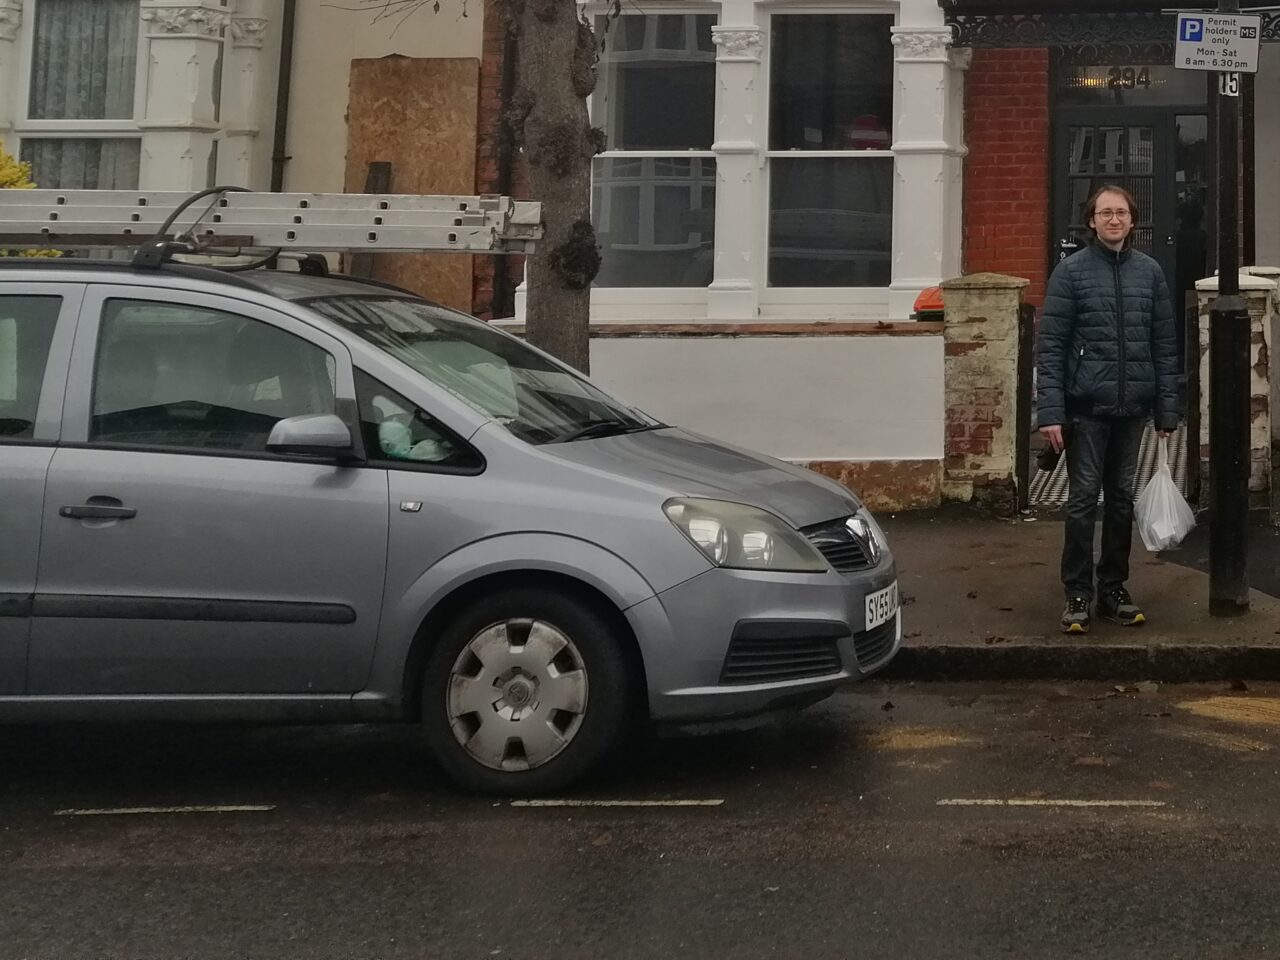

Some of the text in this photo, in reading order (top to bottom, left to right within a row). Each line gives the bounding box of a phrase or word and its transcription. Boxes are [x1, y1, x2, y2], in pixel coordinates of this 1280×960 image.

[1208, 17, 1236, 26] Permit
[1185, 20, 1200, 39] P
[1206, 27, 1237, 35] holders
[1240, 28, 1256, 37] MS
[1212, 37, 1230, 45] only
[1212, 59, 1232, 67] 6.30
[1108, 67, 1150, 90] 294
[1220, 72, 1238, 93] 15
